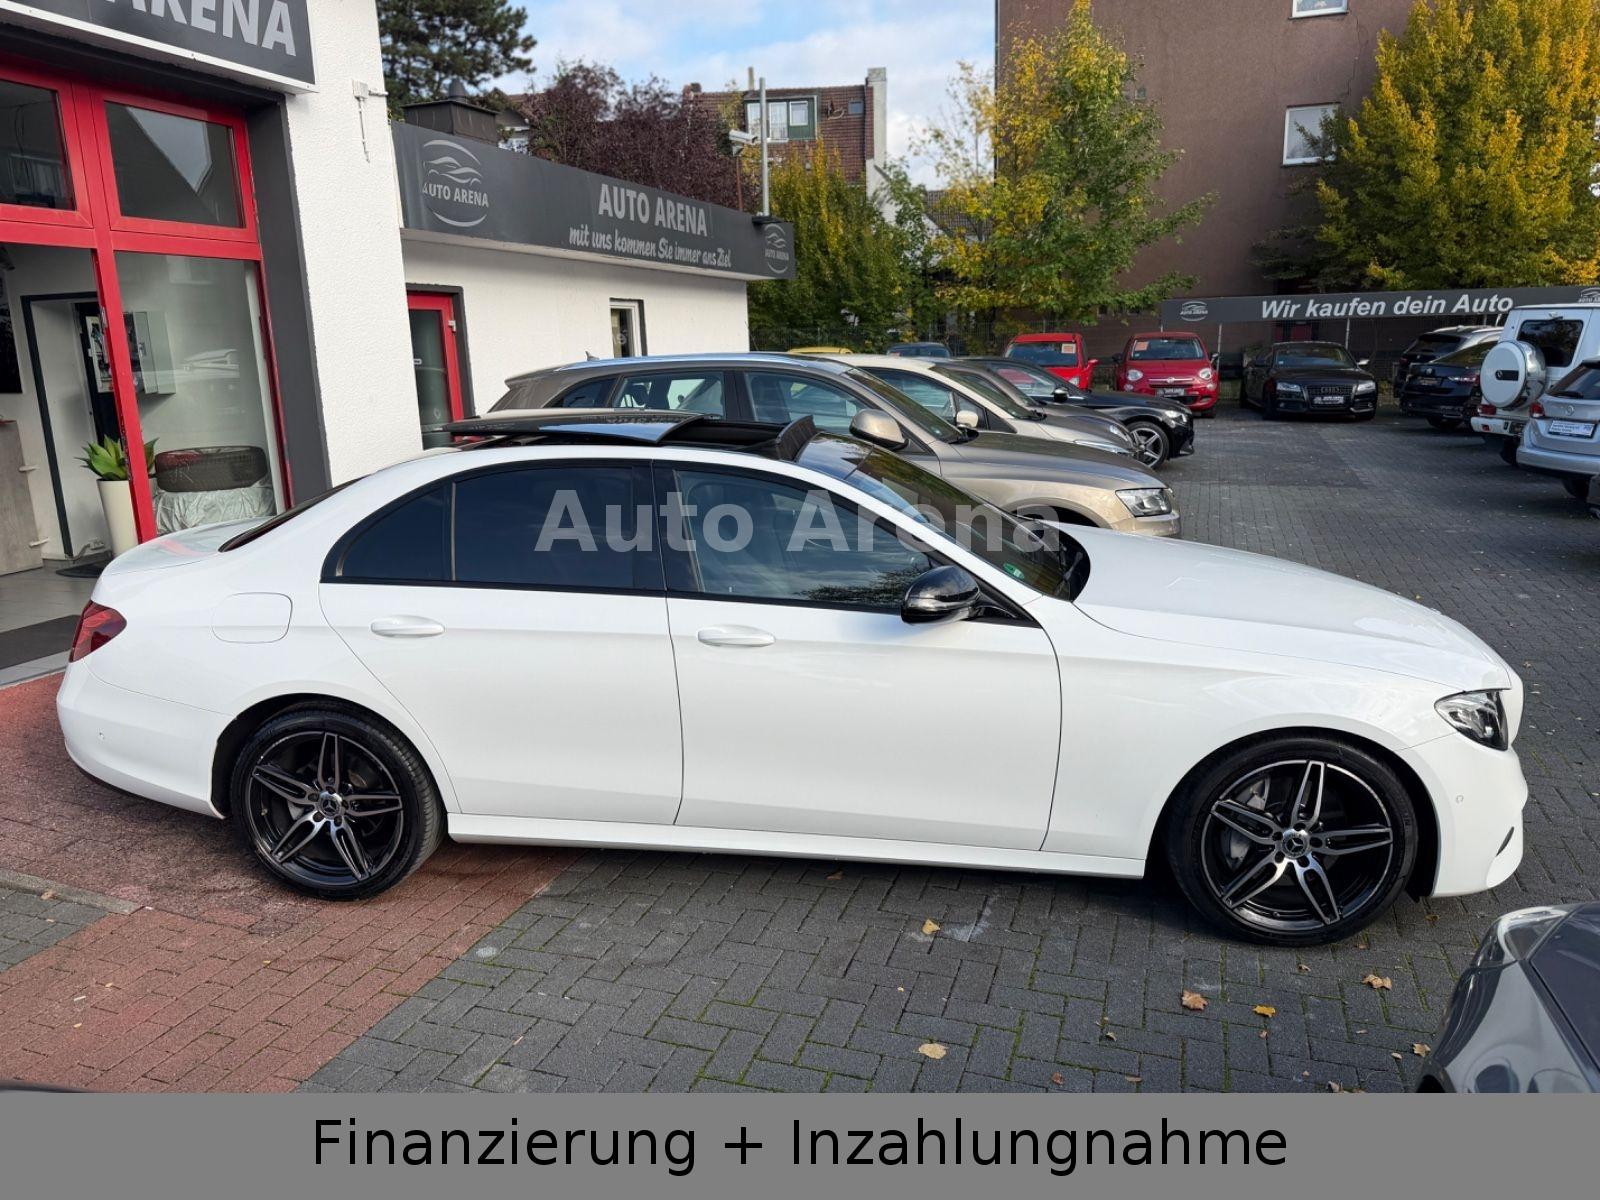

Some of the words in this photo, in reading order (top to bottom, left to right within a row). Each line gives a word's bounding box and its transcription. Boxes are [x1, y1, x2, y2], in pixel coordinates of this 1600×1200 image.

[422, 182, 451, 200] AUTO
[453, 187, 489, 208] ARENA
[598, 183, 650, 224] AUTO
[654, 197, 708, 237] ARENA
[569, 224, 589, 246] mit
[592, 231, 612, 250] uns
[614, 229, 656, 257] kommen
[658, 237, 673, 259] Sie
[674, 241, 701, 263] immer
[1261, 299, 1301, 319] Wir
[1305, 297, 1384, 318] kaufen
[1393, 295, 1446, 316] dein
[1451, 293, 1514, 315] Auto
